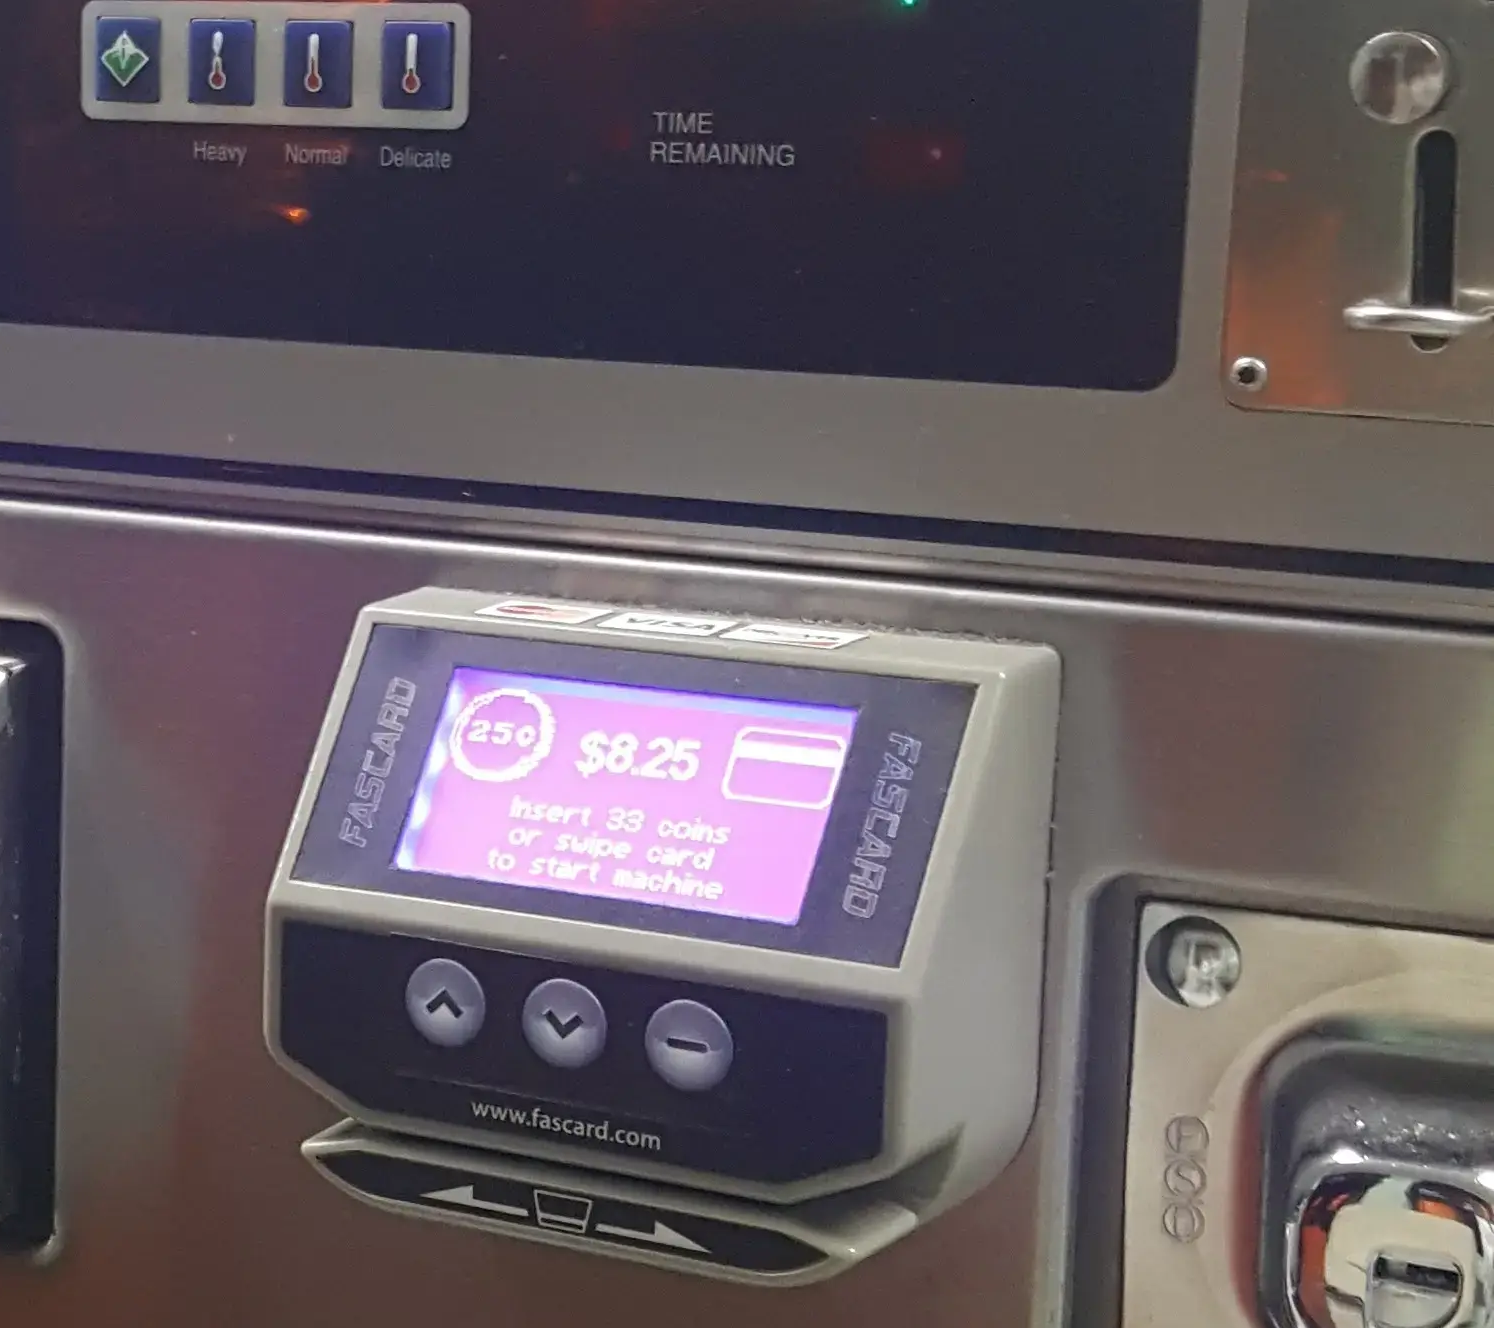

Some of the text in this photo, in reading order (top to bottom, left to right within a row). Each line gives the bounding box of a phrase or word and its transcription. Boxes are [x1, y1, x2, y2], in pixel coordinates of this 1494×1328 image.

[652, 111, 714, 135] TIME
[193, 142, 248, 166] Heavy
[284, 144, 349, 166] Normal
[380, 145, 454, 169] Delicate
[648, 141, 796, 168] REMAINING
[338, 675, 417, 848] FASCARD
[573, 729, 703, 782] $8.25
[508, 793, 733, 845] Insert 33 coins
[841, 731, 922, 919] FASCARD
[507, 826, 717, 872] or swipe card
[486, 847, 725, 902] to start machine
[471, 1100, 662, 1151] www.fascard.com
